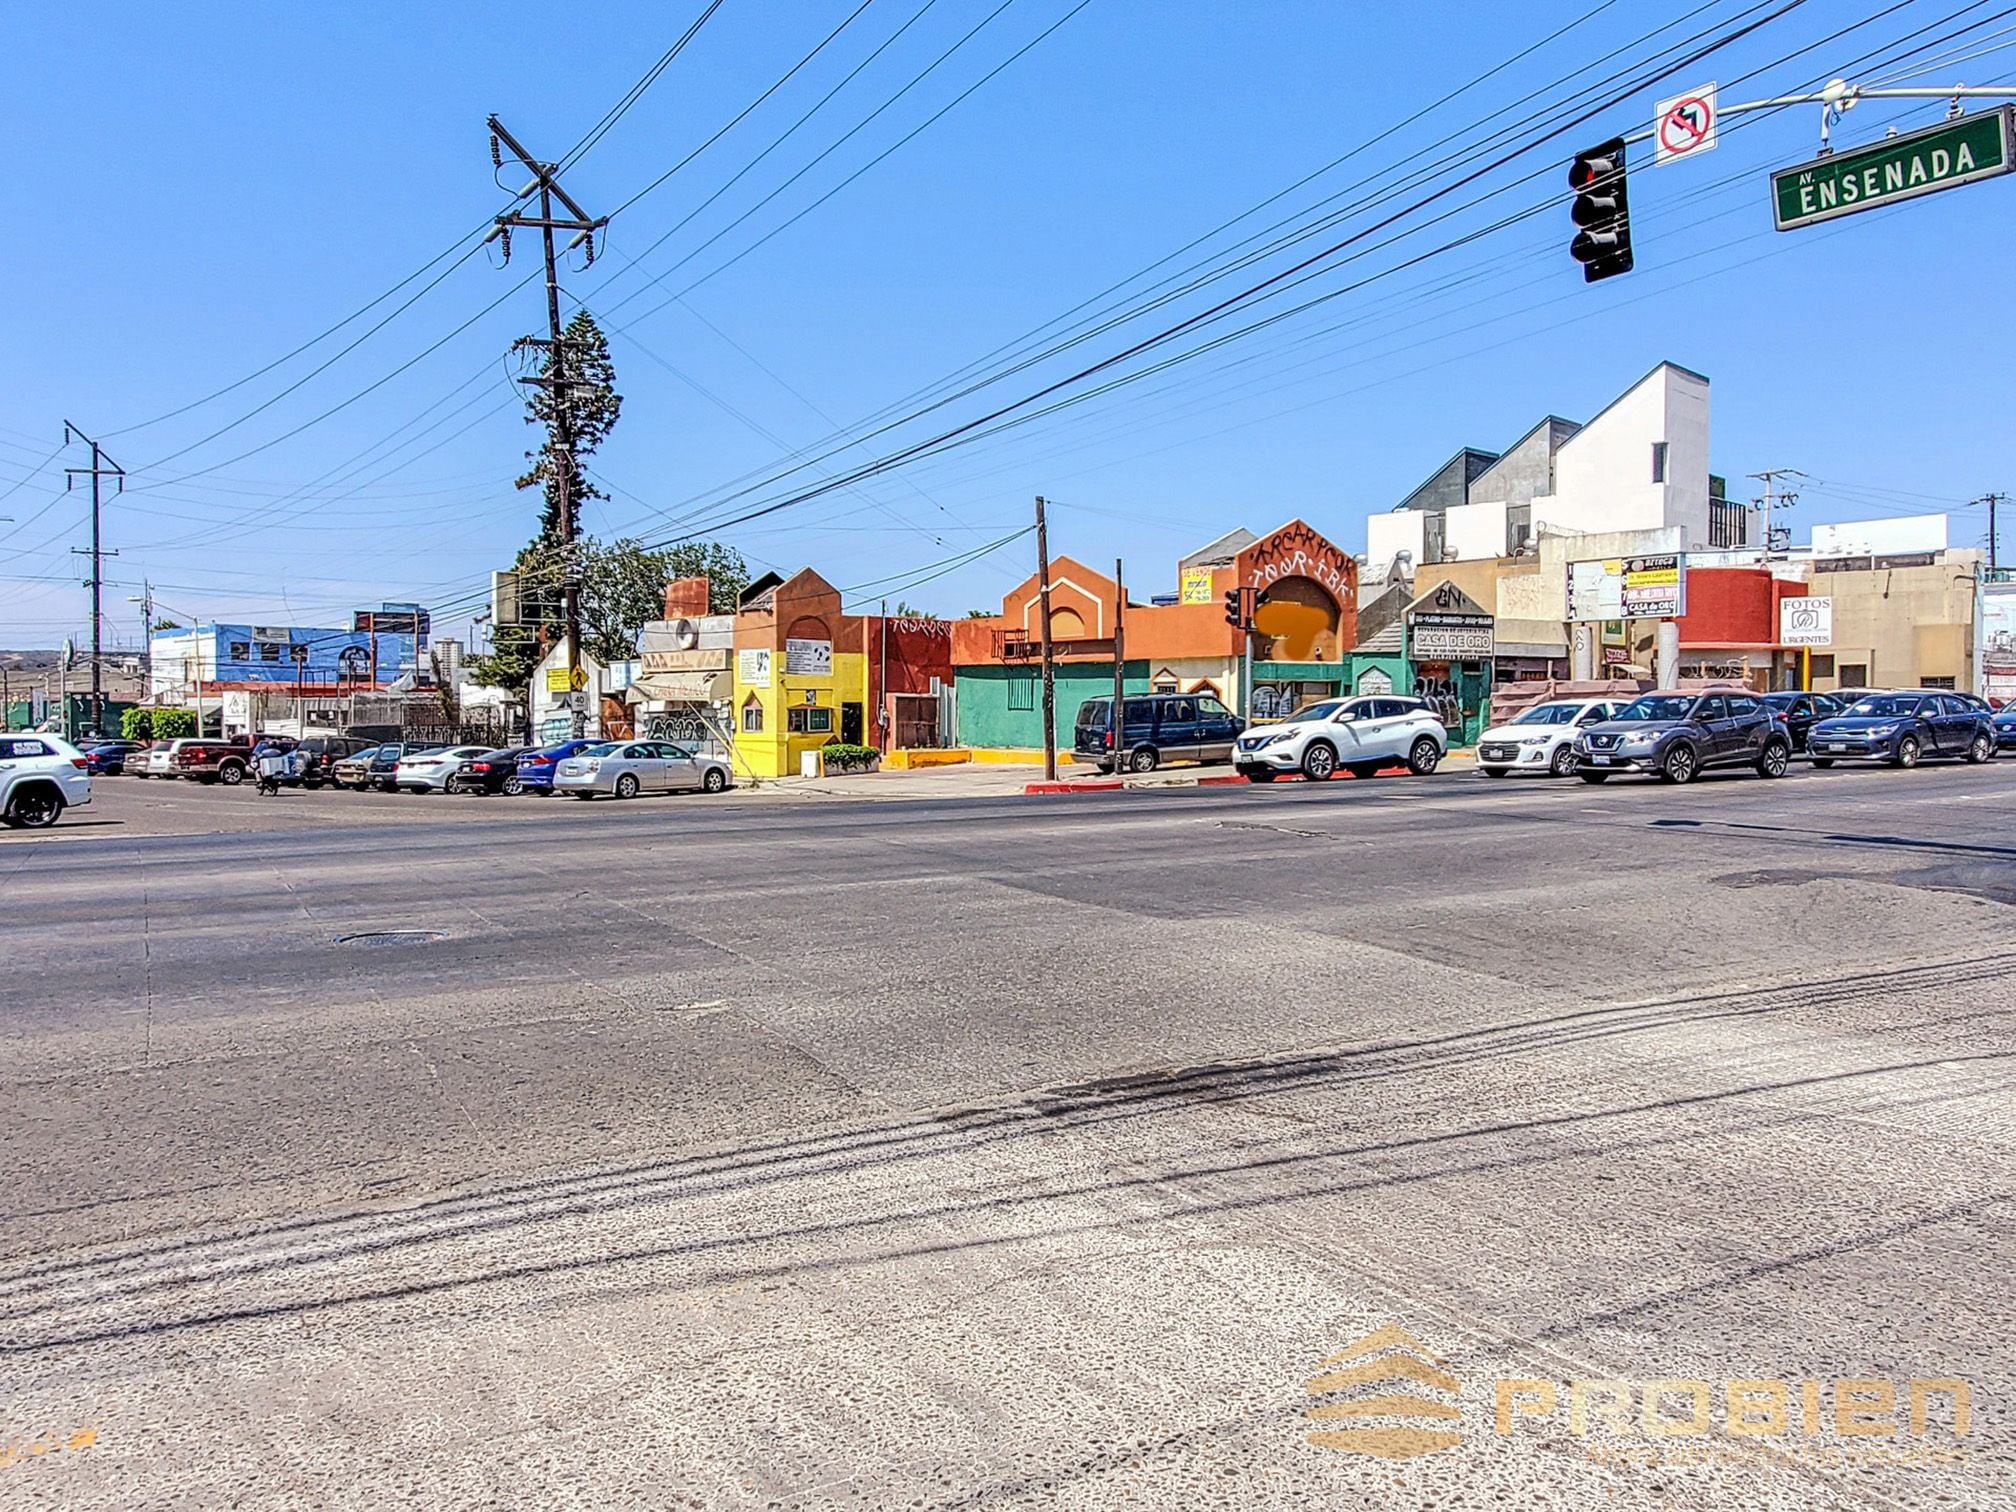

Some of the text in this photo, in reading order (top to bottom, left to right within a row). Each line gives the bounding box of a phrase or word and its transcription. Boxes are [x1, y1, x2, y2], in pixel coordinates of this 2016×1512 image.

[1800, 142, 1976, 214] ENSENADA
[1629, 602, 1648, 612] CASA
[1658, 601, 1675, 610] ORO
[1784, 599, 1830, 610] FOTOS
[1416, 633, 1491, 649] CASA DE ORO
[1783, 635, 1830, 644] URGENTES
[574, 695, 585, 704] 40
